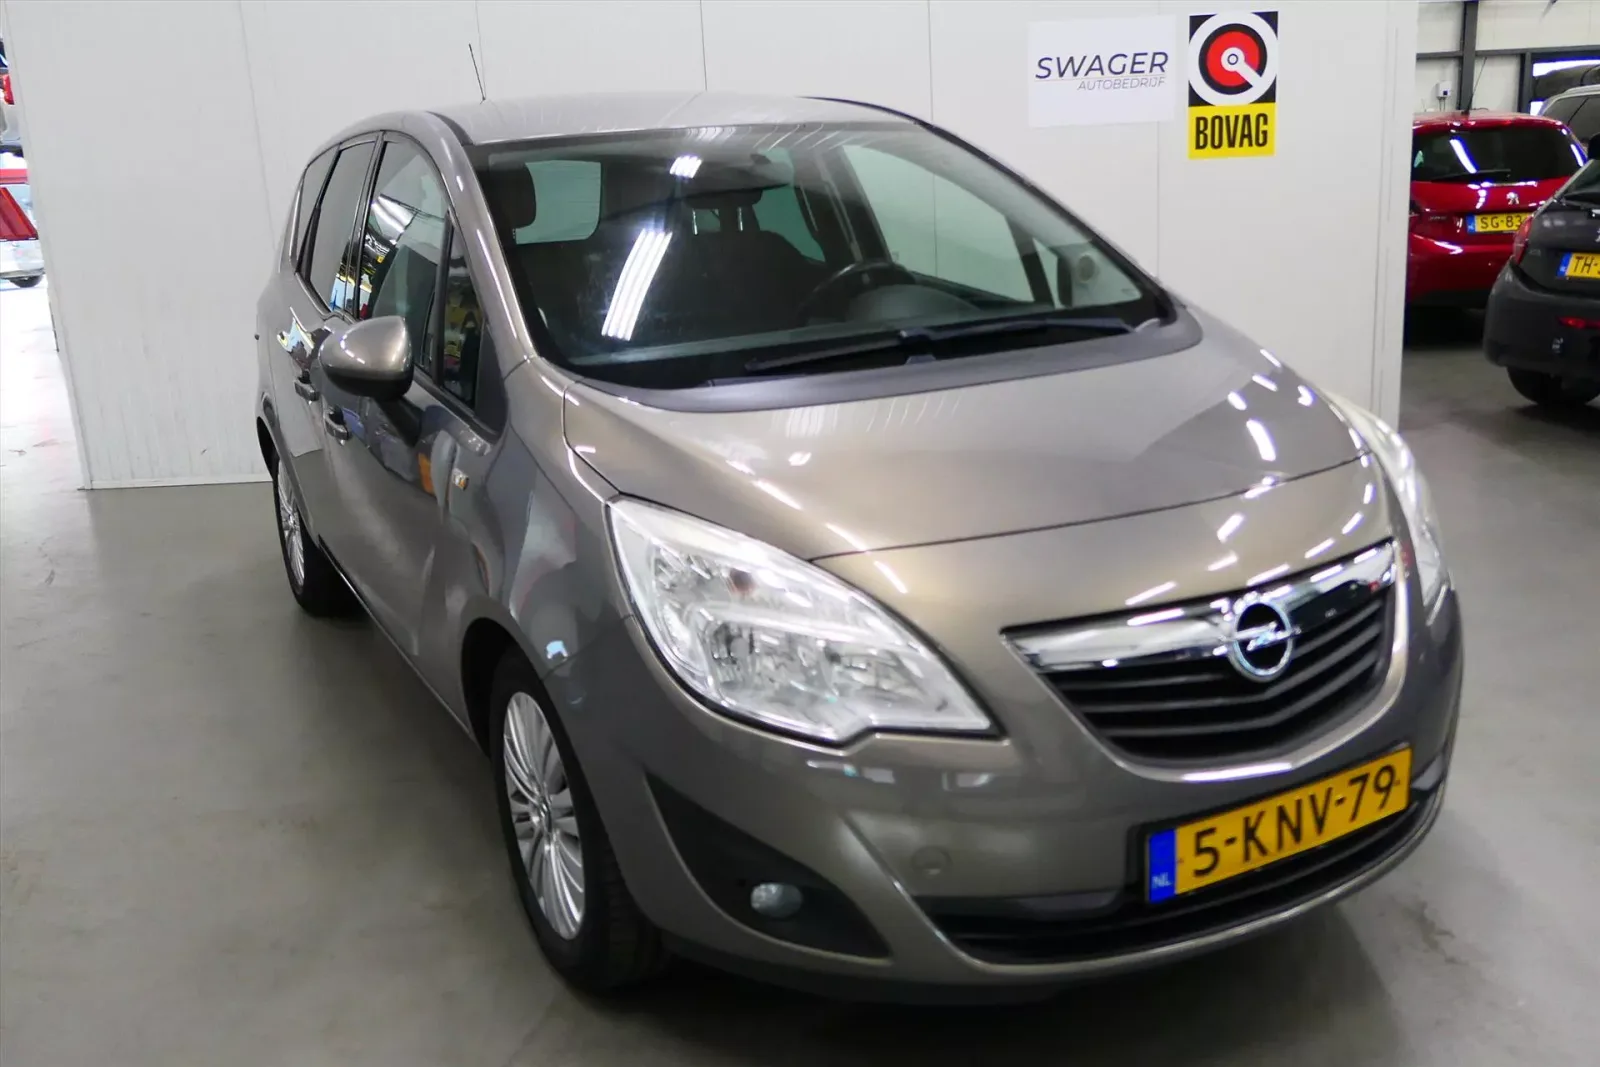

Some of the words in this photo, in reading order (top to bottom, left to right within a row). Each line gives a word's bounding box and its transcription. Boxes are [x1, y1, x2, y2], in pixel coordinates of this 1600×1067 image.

[1035, 51, 1169, 79] SWAGER
[1077, 76, 1166, 91] AUTOBEDRIJF
[1195, 113, 1268, 150] BOVAG
[1573, 255, 1600, 274] TH-
[1193, 764, 1396, 878] 5-KNV-79
[1151, 873, 1172, 889] NL
